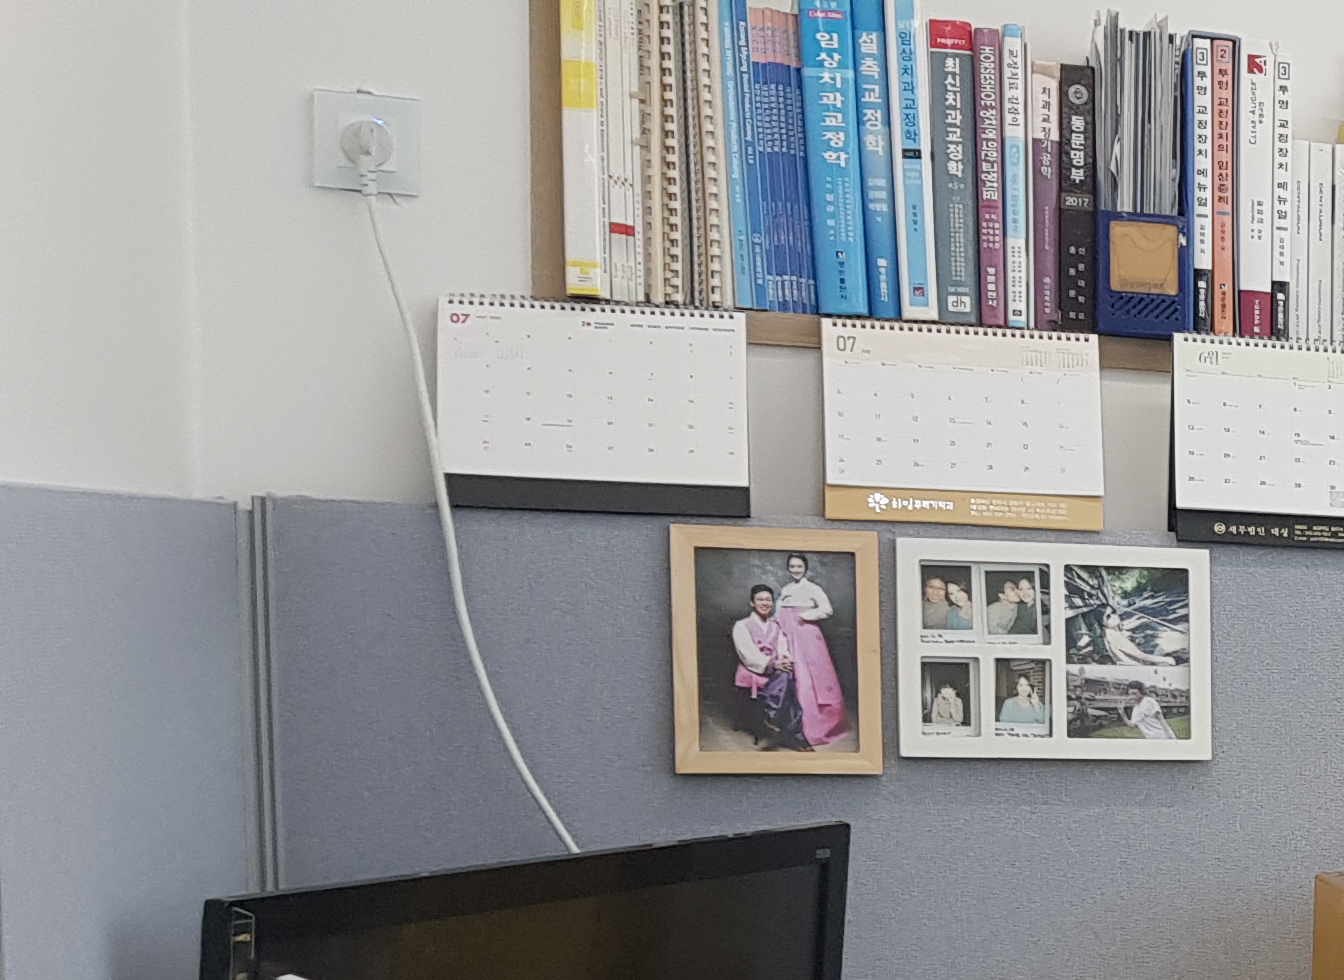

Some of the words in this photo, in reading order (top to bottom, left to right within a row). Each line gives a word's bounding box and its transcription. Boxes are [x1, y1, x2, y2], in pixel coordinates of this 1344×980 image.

[980, 46, 996, 107] HORSESHOE
[1008, 48, 1019, 91] 교정치료
[1198, 51, 1206, 62] 3
[1220, 49, 1227, 59] 2
[1280, 65, 1288, 76] 3
[815, 31, 850, 168] 임상치과교정학
[857, 31, 886, 156] 설측교정학
[898, 30, 919, 145] 임상치과교정학
[1196, 70, 1208, 95] 투명
[1277, 85, 1289, 110] 투명
[943, 57, 964, 178] 최신치과교정학
[1196, 105, 1208, 159] 교정장치
[1217, 97, 1229, 154] 교정장치의
[1069, 115, 1086, 184] 동문명부
[1277, 119, 1289, 172] 교정장치
[1065, 196, 1089, 208] 2017
[449, 312, 471, 324] 07
[836, 335, 857, 352] 07
